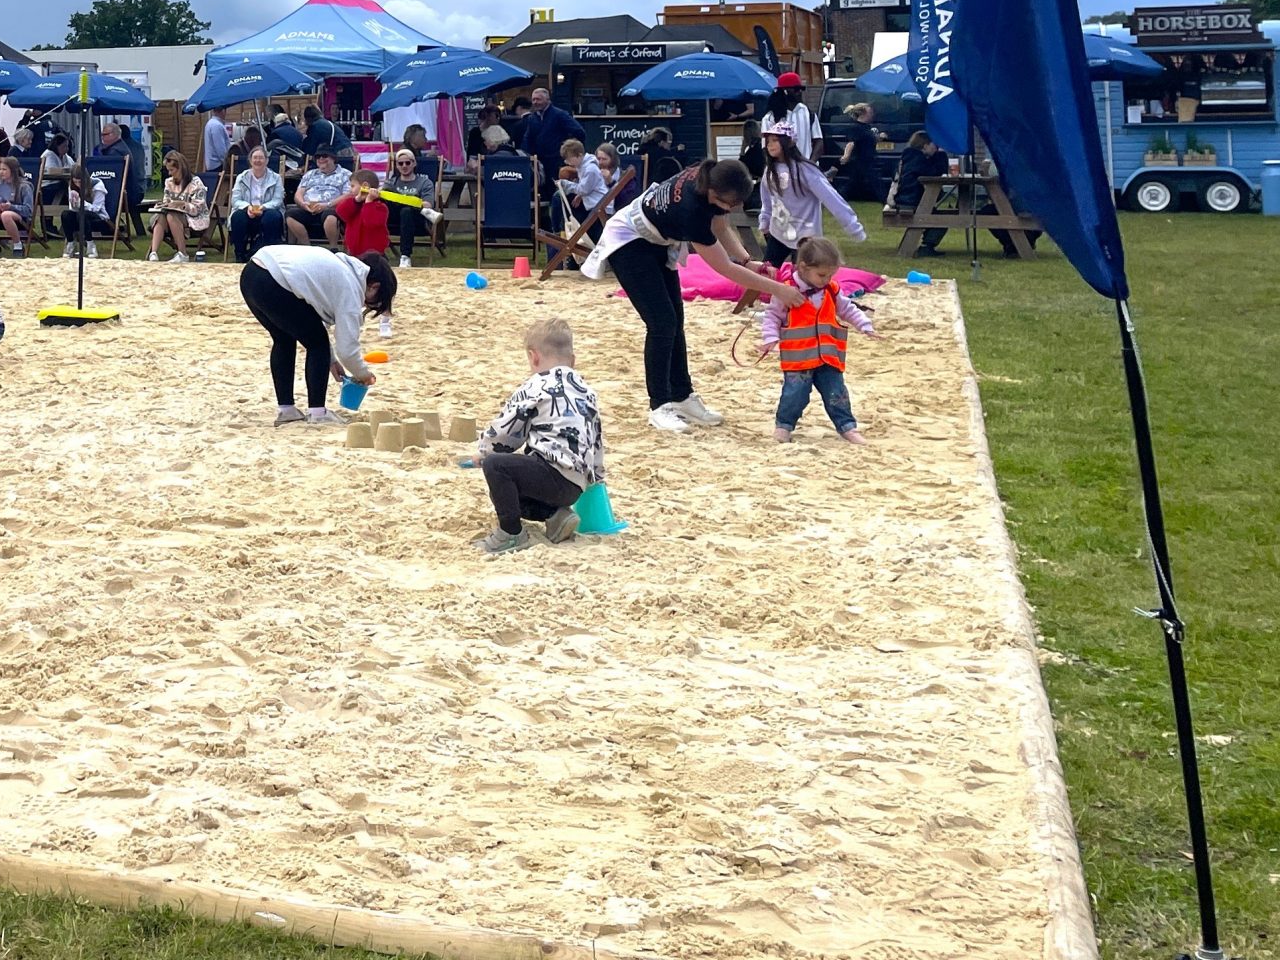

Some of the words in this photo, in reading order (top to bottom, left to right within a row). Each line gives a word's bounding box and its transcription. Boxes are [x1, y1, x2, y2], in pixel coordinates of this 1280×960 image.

[1138, 14, 1252, 31] HORSEBOX
[275, 32, 336, 42] ADNAMS
[577, 47, 616, 62] Pinney's
[618, 47, 630, 58] of
[631, 46, 662, 58] Orford
[674, 70, 715, 78] ADNAMS
[492, 171, 523, 180] ADNAMS
